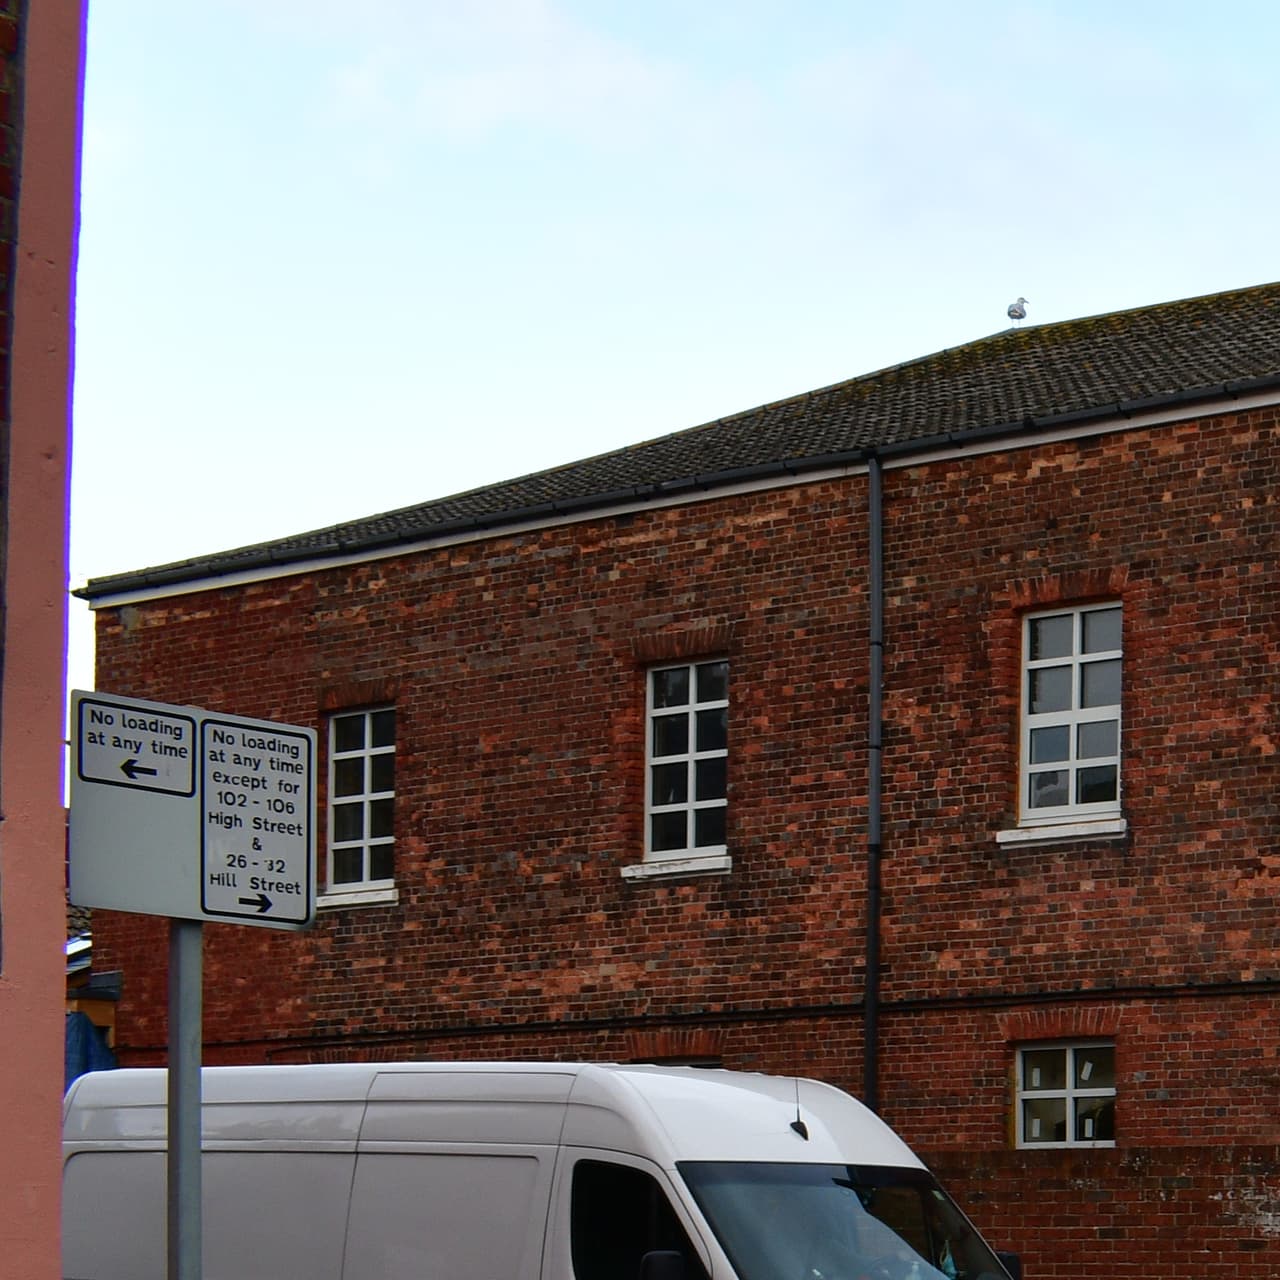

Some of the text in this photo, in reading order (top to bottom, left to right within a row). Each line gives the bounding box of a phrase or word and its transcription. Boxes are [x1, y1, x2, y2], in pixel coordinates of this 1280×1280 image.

[90, 709, 183, 740] No loading
[88, 732, 188, 759] at any time
[212, 729, 300, 759] No loading
[209, 750, 304, 775] at any time
[212, 771, 300, 795] except for
[217, 791, 248, 808] 102
[266, 798, 295, 815] 106
[208, 811, 304, 837] High Street
[251, 837, 262, 851] &
[226, 854, 248, 869] 26
[209, 873, 302, 896] Hill Street
